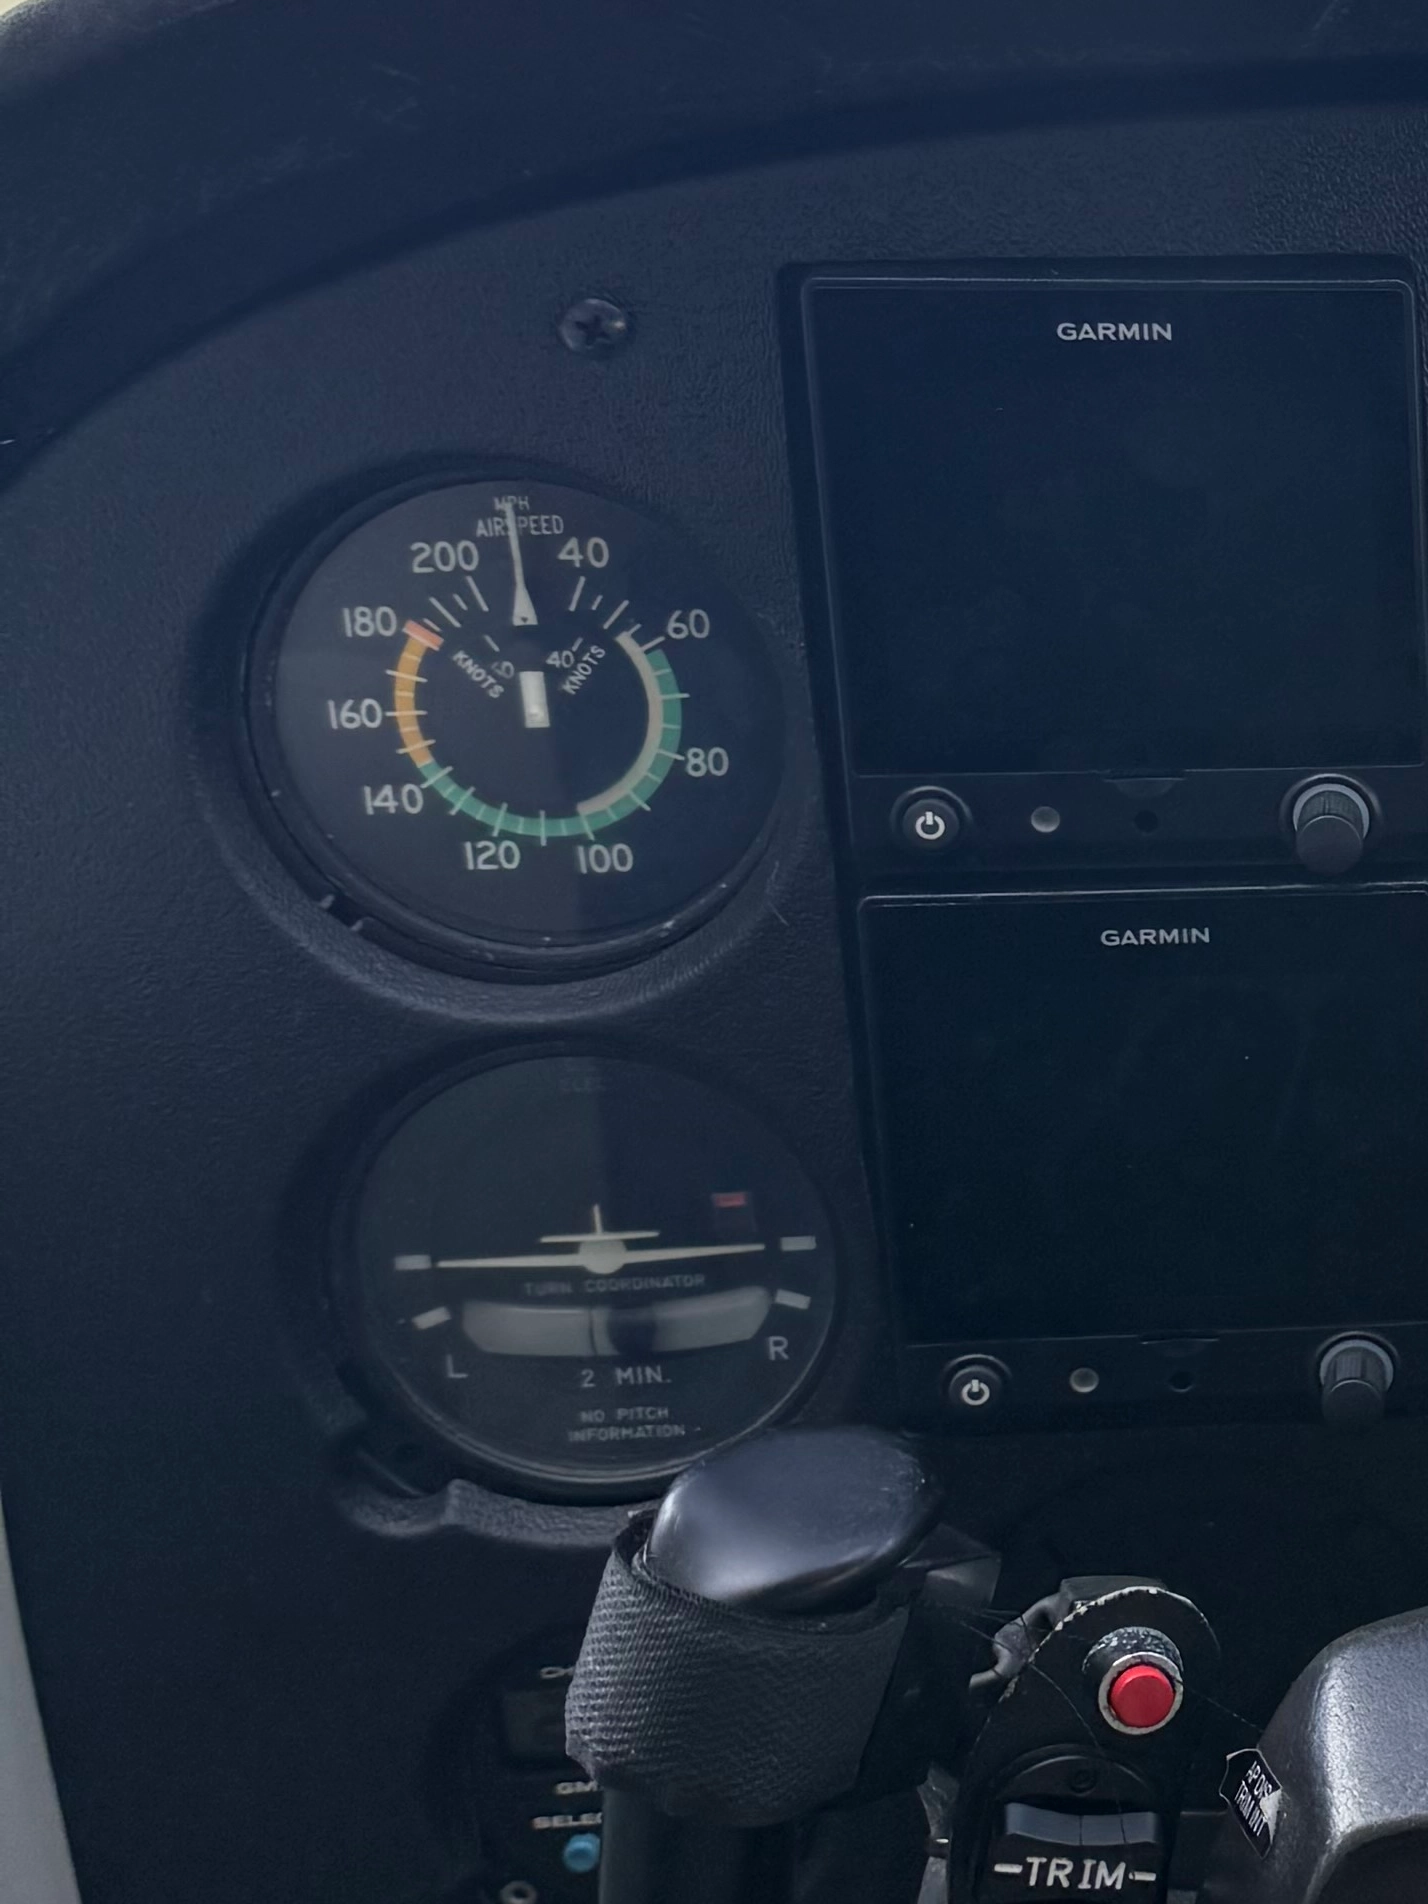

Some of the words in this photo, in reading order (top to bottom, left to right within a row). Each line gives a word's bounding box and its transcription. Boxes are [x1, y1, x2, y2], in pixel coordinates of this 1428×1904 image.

[1055, 321, 1174, 342] GARMIN
[493, 495, 530, 512] MPH
[475, 514, 564, 538] AIRSPEED
[410, 539, 479, 573] 200
[557, 536, 609, 569] 40
[342, 606, 397, 638] 180
[666, 607, 711, 639] 60
[452, 649, 505, 699] KNOTS
[545, 649, 574, 669] 40
[560, 644, 607, 696] KNOTS
[329, 698, 382, 730] 160
[685, 747, 729, 777] 80
[362, 784, 424, 816] 140
[463, 840, 521, 871] 120
[577, 843, 633, 874] 100
[1099, 926, 1211, 947] GARMIN
[581, 1272, 706, 1294] COORDINATOR
[768, 1336, 790, 1361] R
[579, 1368, 597, 1388] 2
[614, 1364, 673, 1386] MIN.
[579, 1408, 606, 1424] NO
[616, 1405, 670, 1421] PITCH
[567, 1424, 686, 1443] INFORMATION
